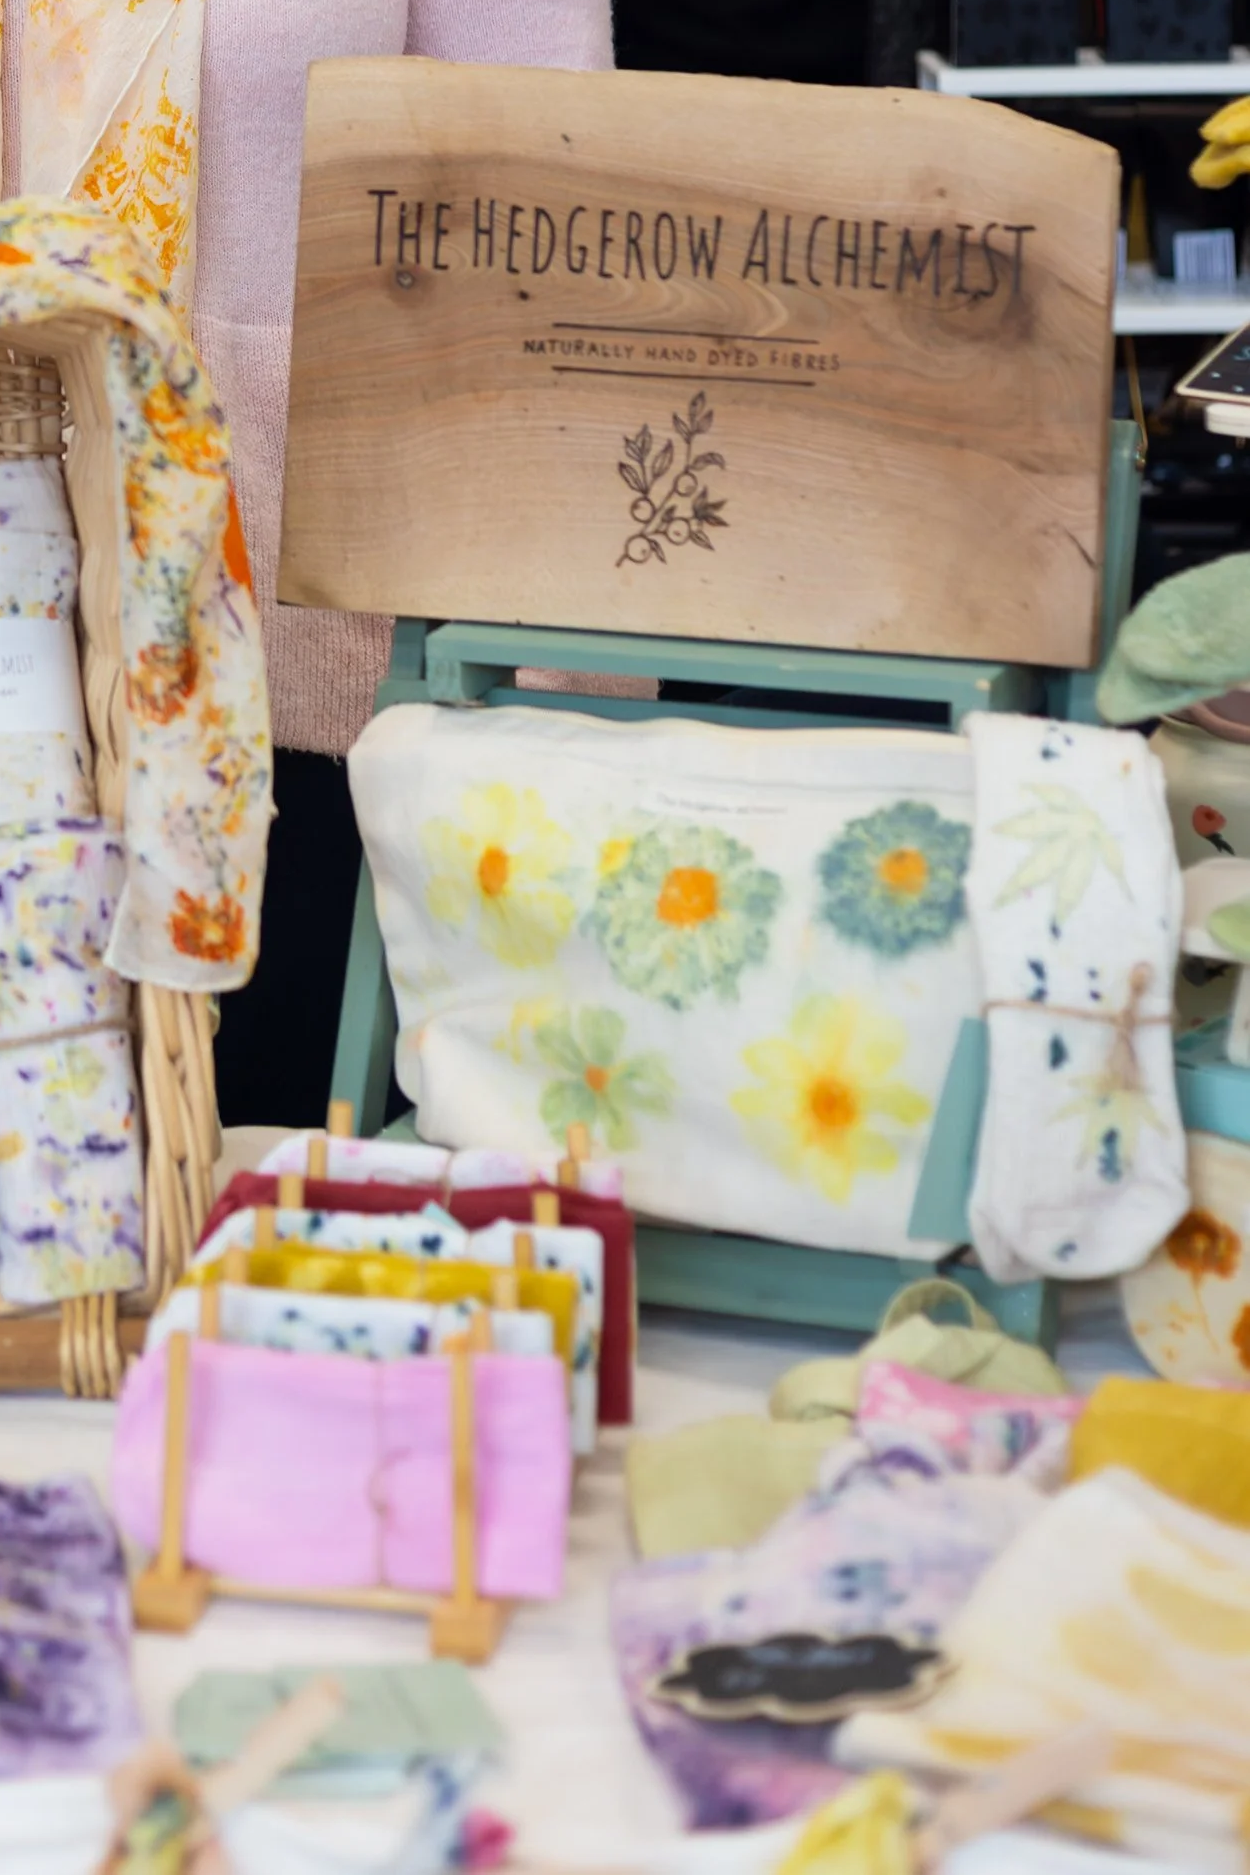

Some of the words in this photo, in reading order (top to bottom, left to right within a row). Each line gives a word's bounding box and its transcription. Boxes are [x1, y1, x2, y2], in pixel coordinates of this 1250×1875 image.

[367, 189, 451, 270] THE
[473, 197, 723, 281] HEDGEROW
[742, 208, 1036, 299] ALCHEMIST
[522, 339, 635, 360] NATURALLY
[645, 347, 697, 364] HAND
[707, 349, 759, 368] DYED
[769, 354, 841, 372] FIBRES
